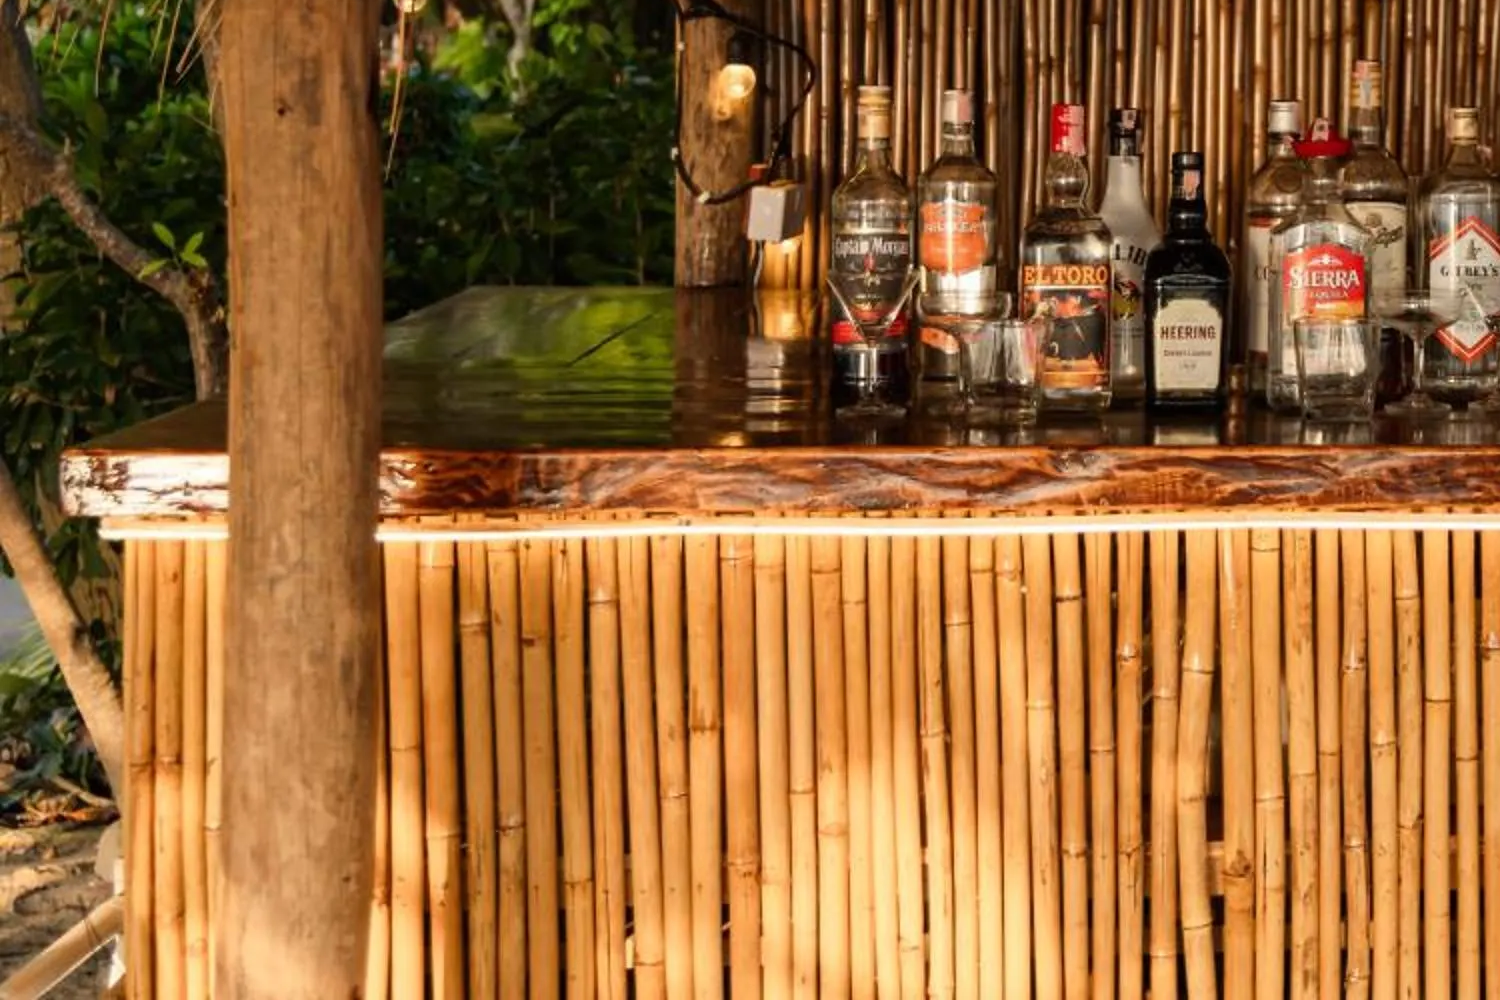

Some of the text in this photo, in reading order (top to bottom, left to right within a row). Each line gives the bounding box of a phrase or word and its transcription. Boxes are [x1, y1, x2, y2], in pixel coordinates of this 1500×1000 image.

[1023, 264, 1109, 286] EL TORO
[1288, 266, 1360, 290] SIERRA
[1160, 324, 1217, 341] HEERING
